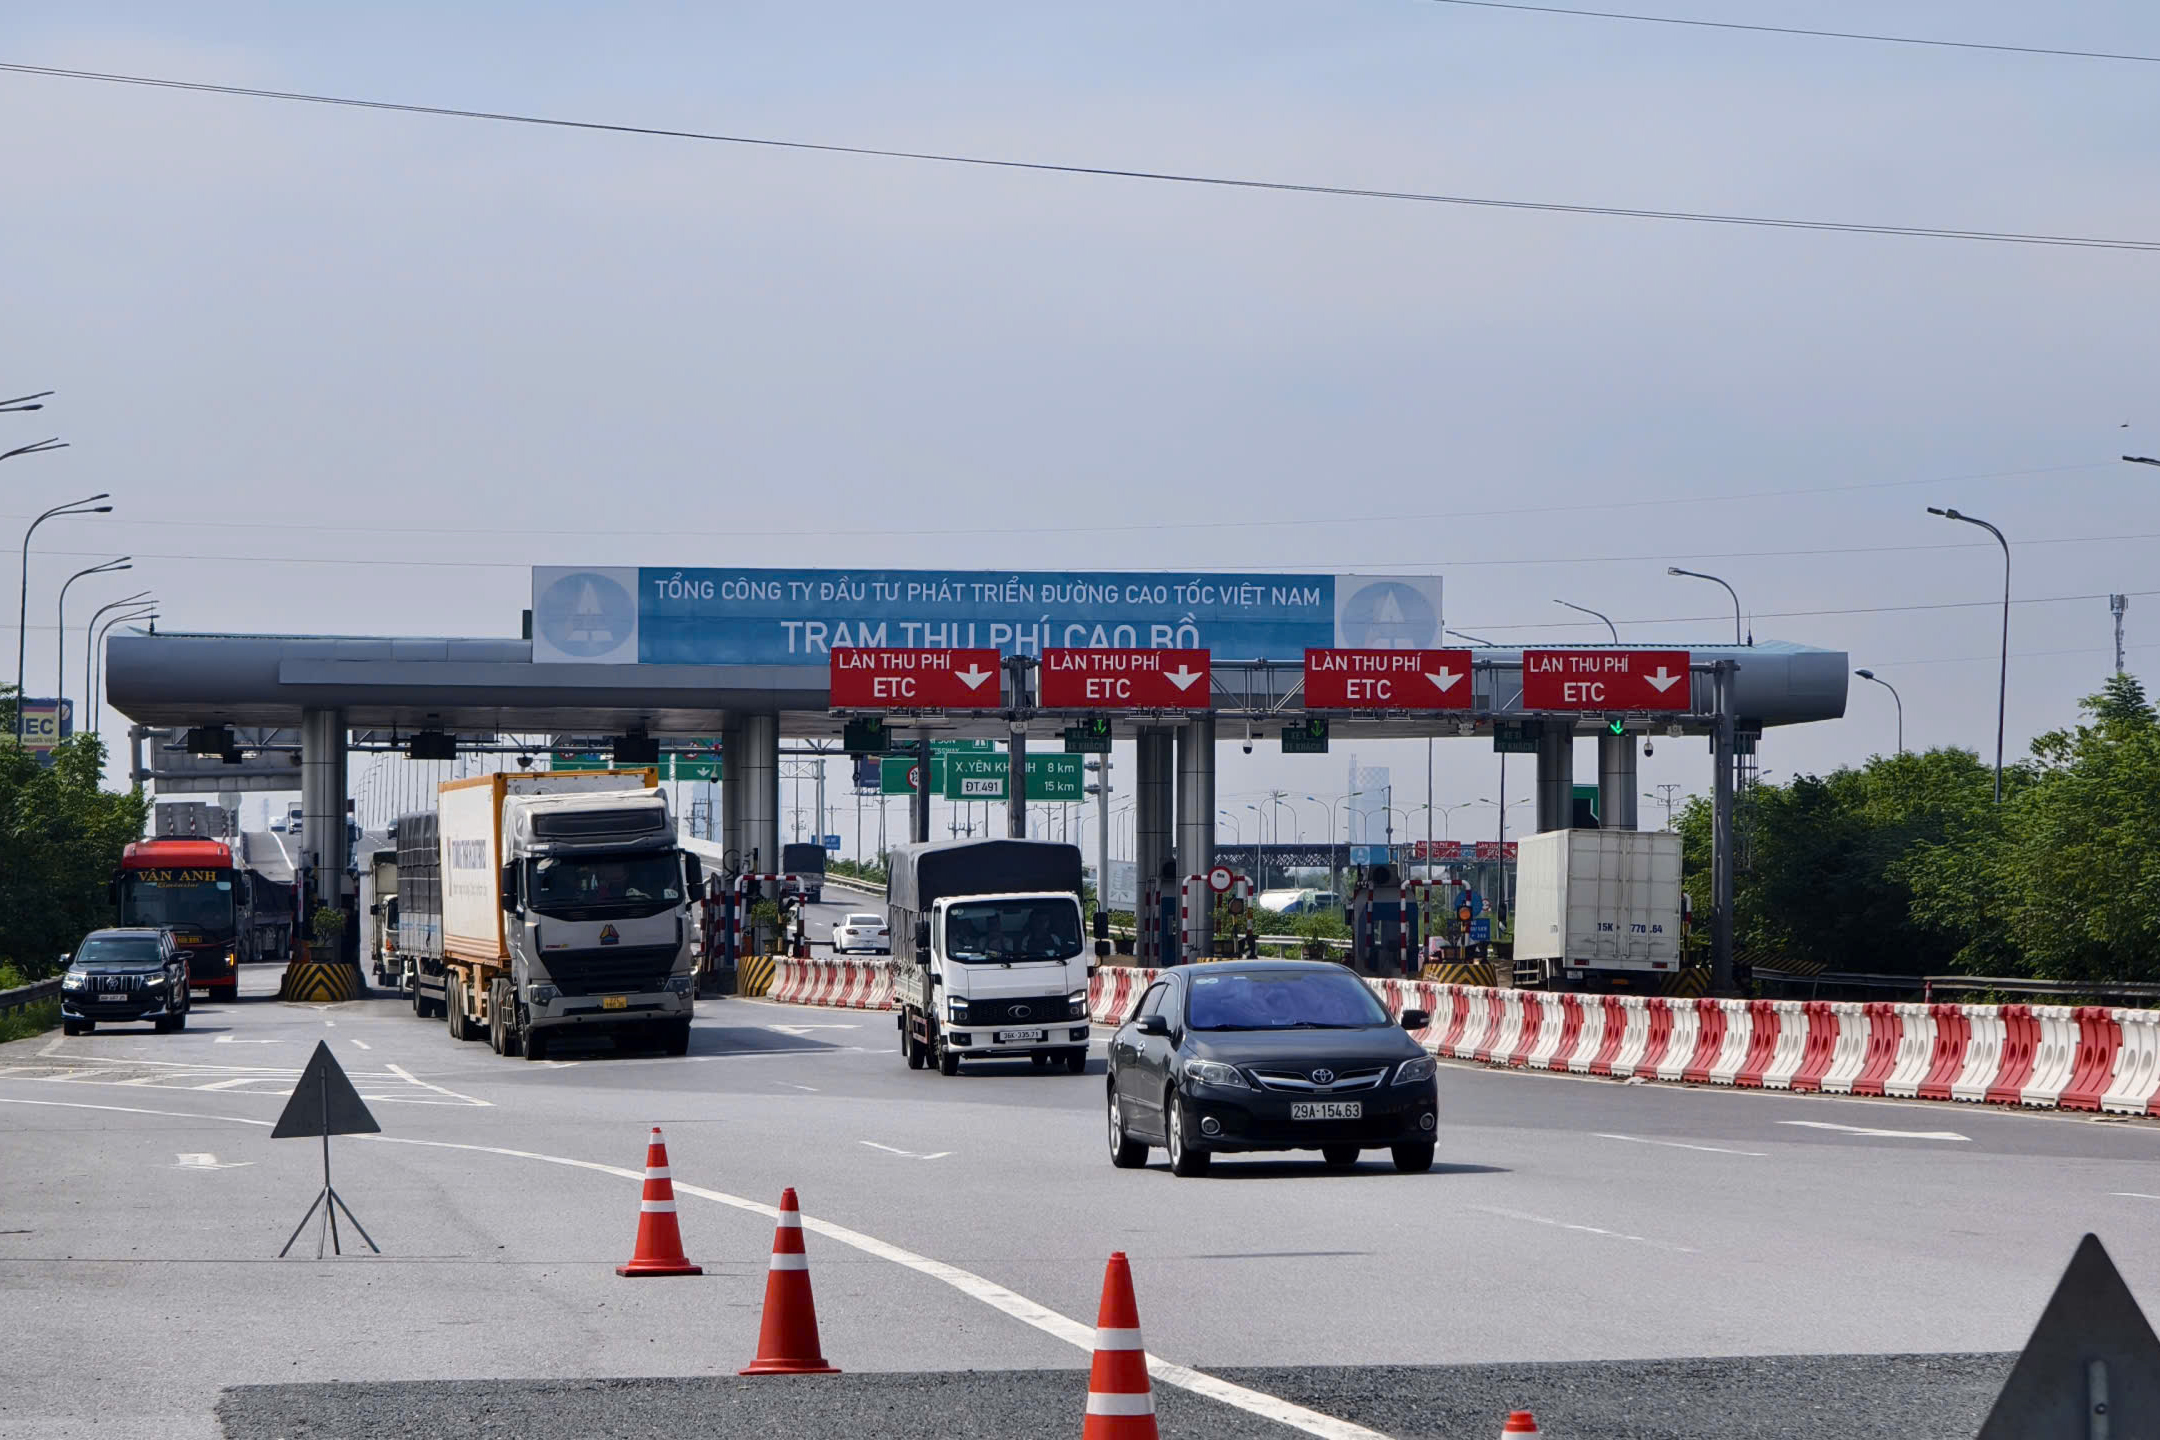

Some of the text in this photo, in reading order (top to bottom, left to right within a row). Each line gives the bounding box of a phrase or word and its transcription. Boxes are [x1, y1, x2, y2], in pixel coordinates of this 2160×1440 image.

[655, 572, 1320, 610] TỔNG CÔNG TY ĐẦU TƯ PHÁT TRIỂN ĐƯỜNG CAO TỐC VIỆT NAM
[990, 614, 1050, 656] PHÍ
[1064, 623, 1137, 648] CAO
[839, 650, 952, 670] LÀN THU PHÍ
[1050, 651, 1161, 671] LÀN THU PHÍ
[1311, 651, 1422, 672] LÀN THU PHÍ
[1569, 657, 1600, 673] THU
[1604, 654, 1629, 673] PHÍ
[873, 677, 916, 698] ETC
[1086, 678, 1131, 699] ETC
[1347, 679, 1391, 700] ETC
[1563, 682, 1606, 702] ETC
[1048, 763, 1055, 773] 8
[1058, 762, 1075, 773] km
[966, 781, 998, 793] ĐT.491
[1045, 781, 1075, 792] 15 km
[138, 868, 217, 881] VÂN ANH
[1597, 922, 1614, 932] 15K
[1293, 1104, 1360, 1118] 29A-154.63
